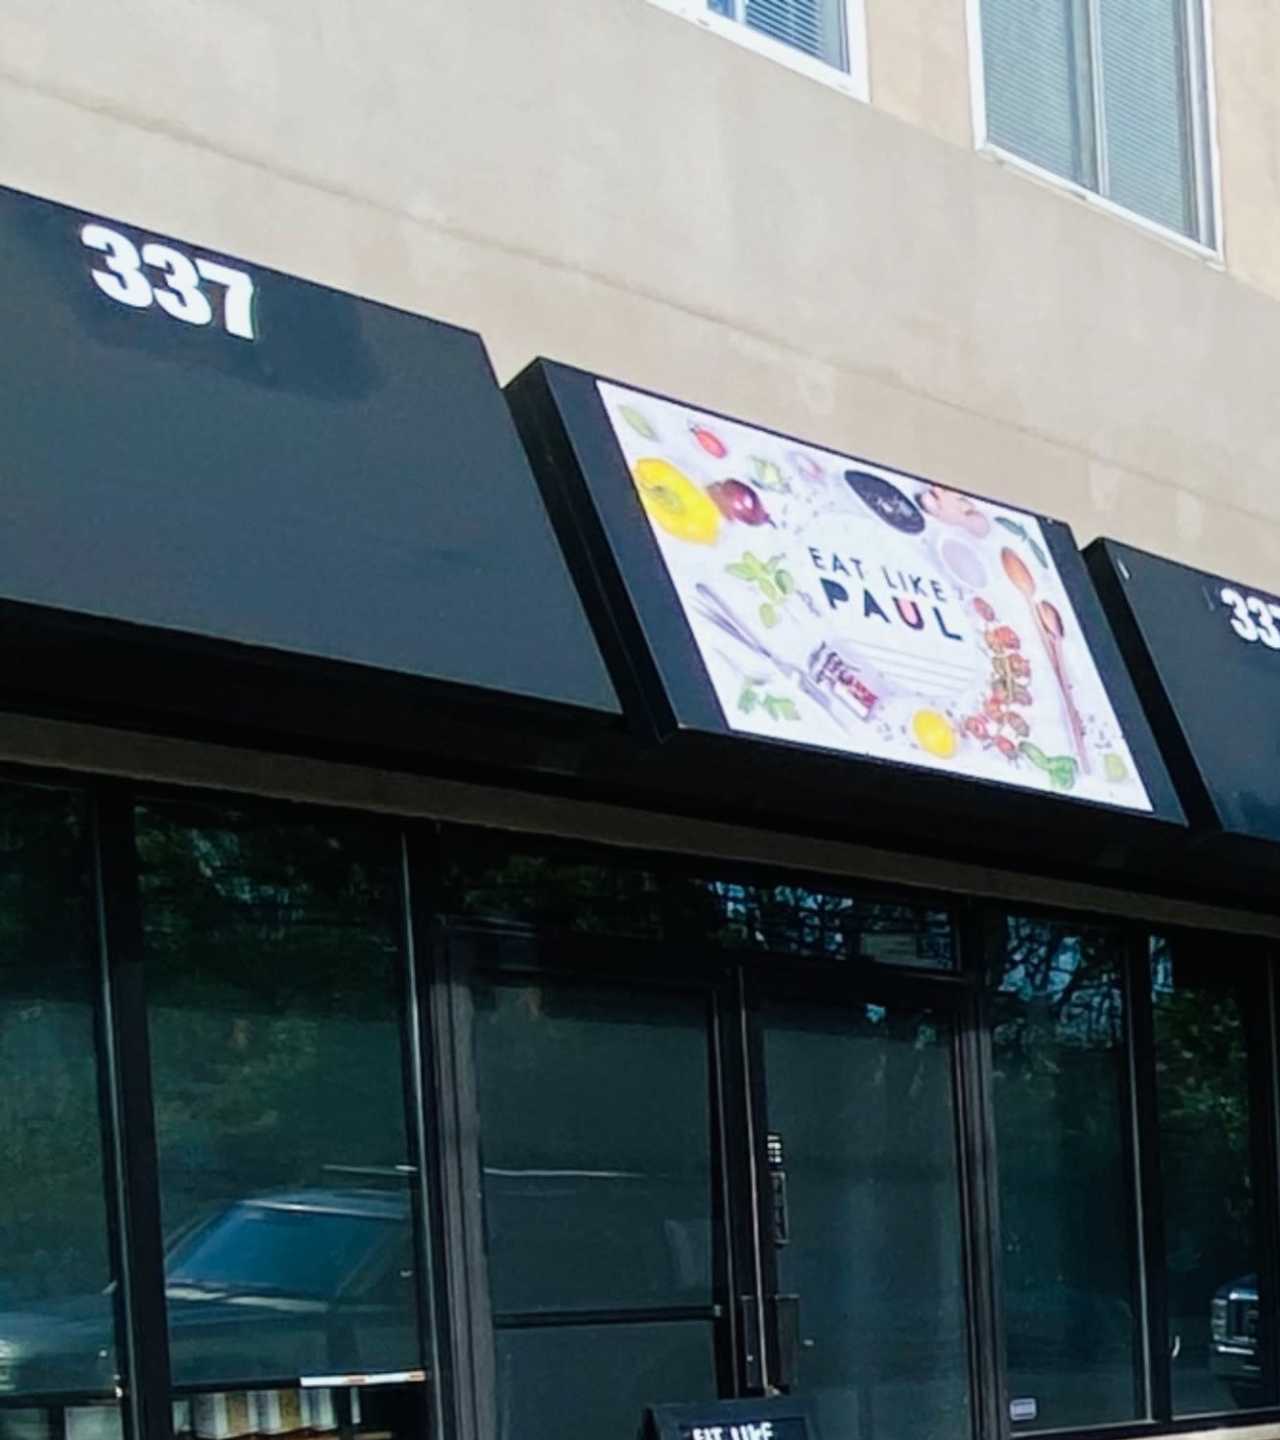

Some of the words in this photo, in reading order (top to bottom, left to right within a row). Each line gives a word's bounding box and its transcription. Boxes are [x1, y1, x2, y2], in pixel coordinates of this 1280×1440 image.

[81, 224, 255, 339] 337
[808, 546, 864, 580] EAT
[880, 565, 947, 601] LIKE
[820, 577, 963, 641] PAUL
